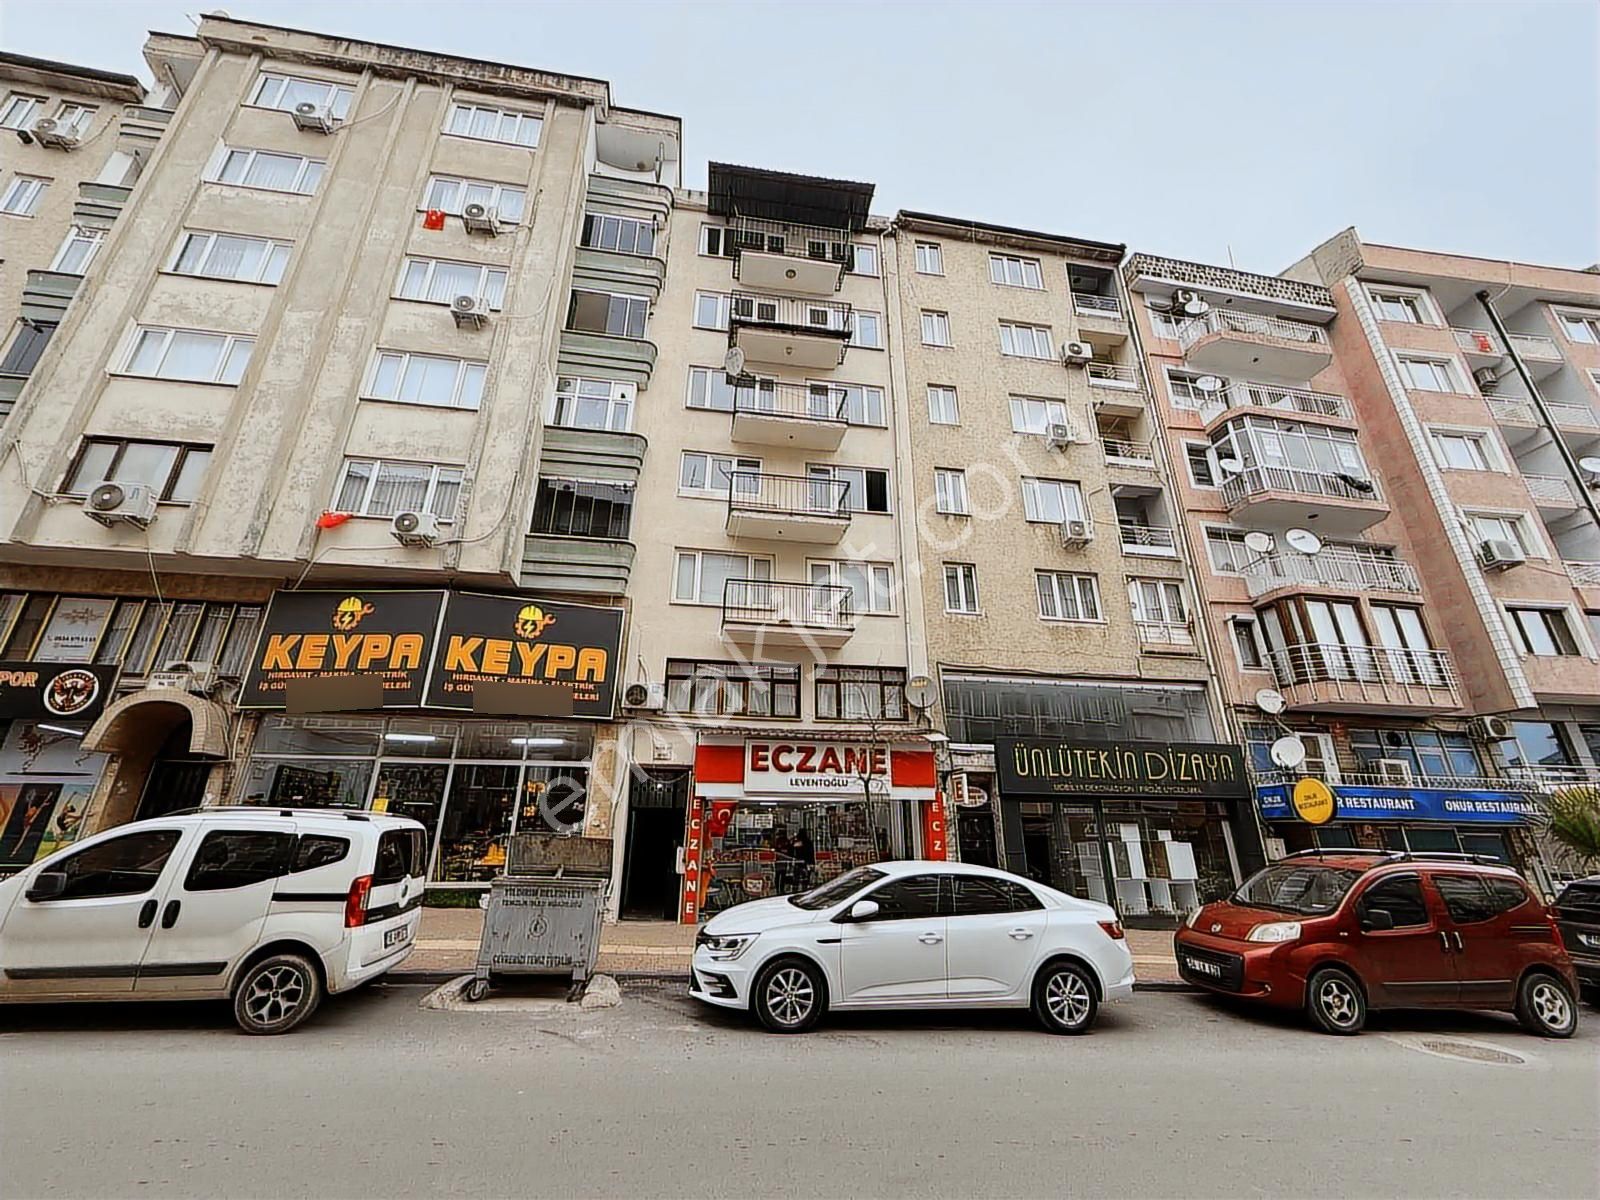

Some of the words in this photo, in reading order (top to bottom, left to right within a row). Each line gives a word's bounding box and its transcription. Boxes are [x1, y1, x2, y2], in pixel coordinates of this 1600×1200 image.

[261, 634, 424, 670] KEYPA
[445, 635, 608, 682] KEYPA
[267, 671, 314, 679] HIRDAVAT
[452, 672, 498, 682] HIRDAVAT
[751, 744, 887, 775] ECZANE
[790, 778, 849, 788] LEVENTOĞLU
[1346, 798, 1415, 810] RESTAURANT
[1445, 800, 1475, 812] ONUR
[932, 802, 942, 862] ECZ
[686, 799, 701, 913] ECZANE
